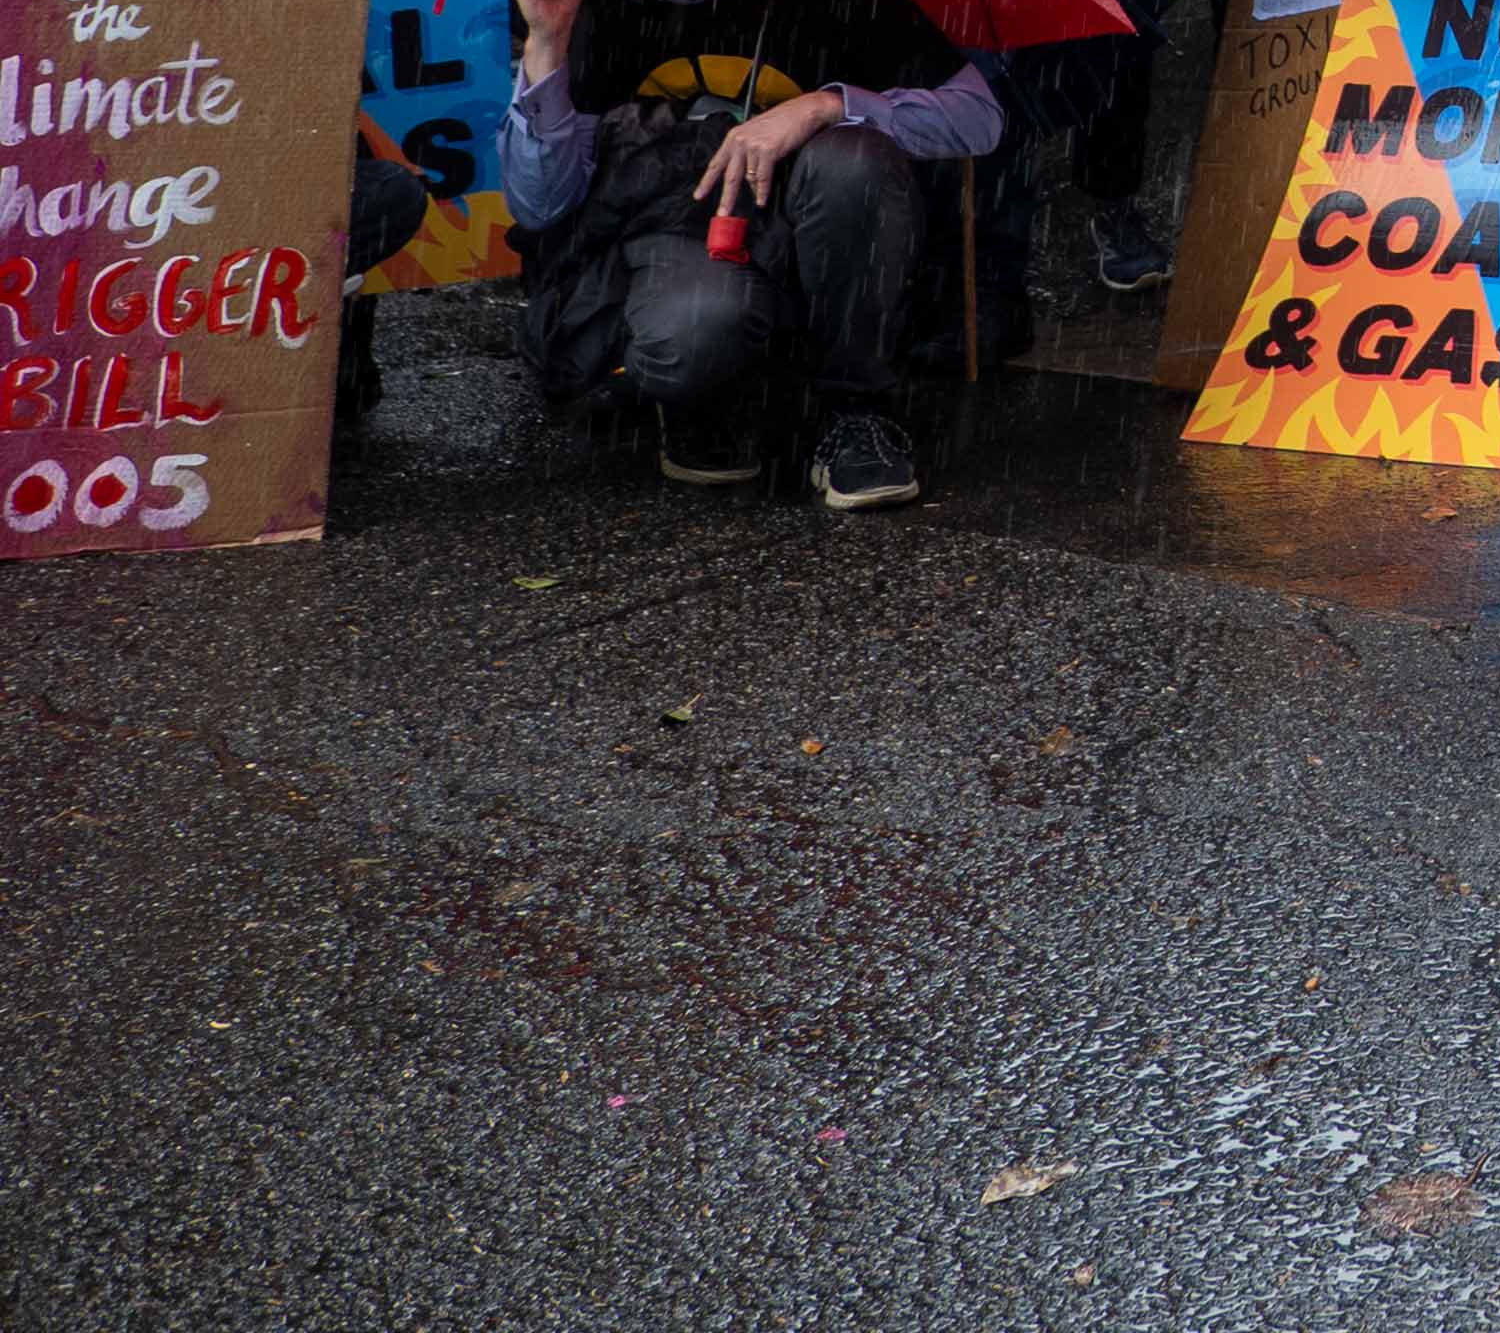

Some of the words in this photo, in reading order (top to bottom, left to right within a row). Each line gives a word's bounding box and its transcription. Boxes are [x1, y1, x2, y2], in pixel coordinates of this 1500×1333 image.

[1239, 13, 1336, 80] TOXI
[1244, 296, 1318, 374] &
[0, 350, 223, 431] BILL
